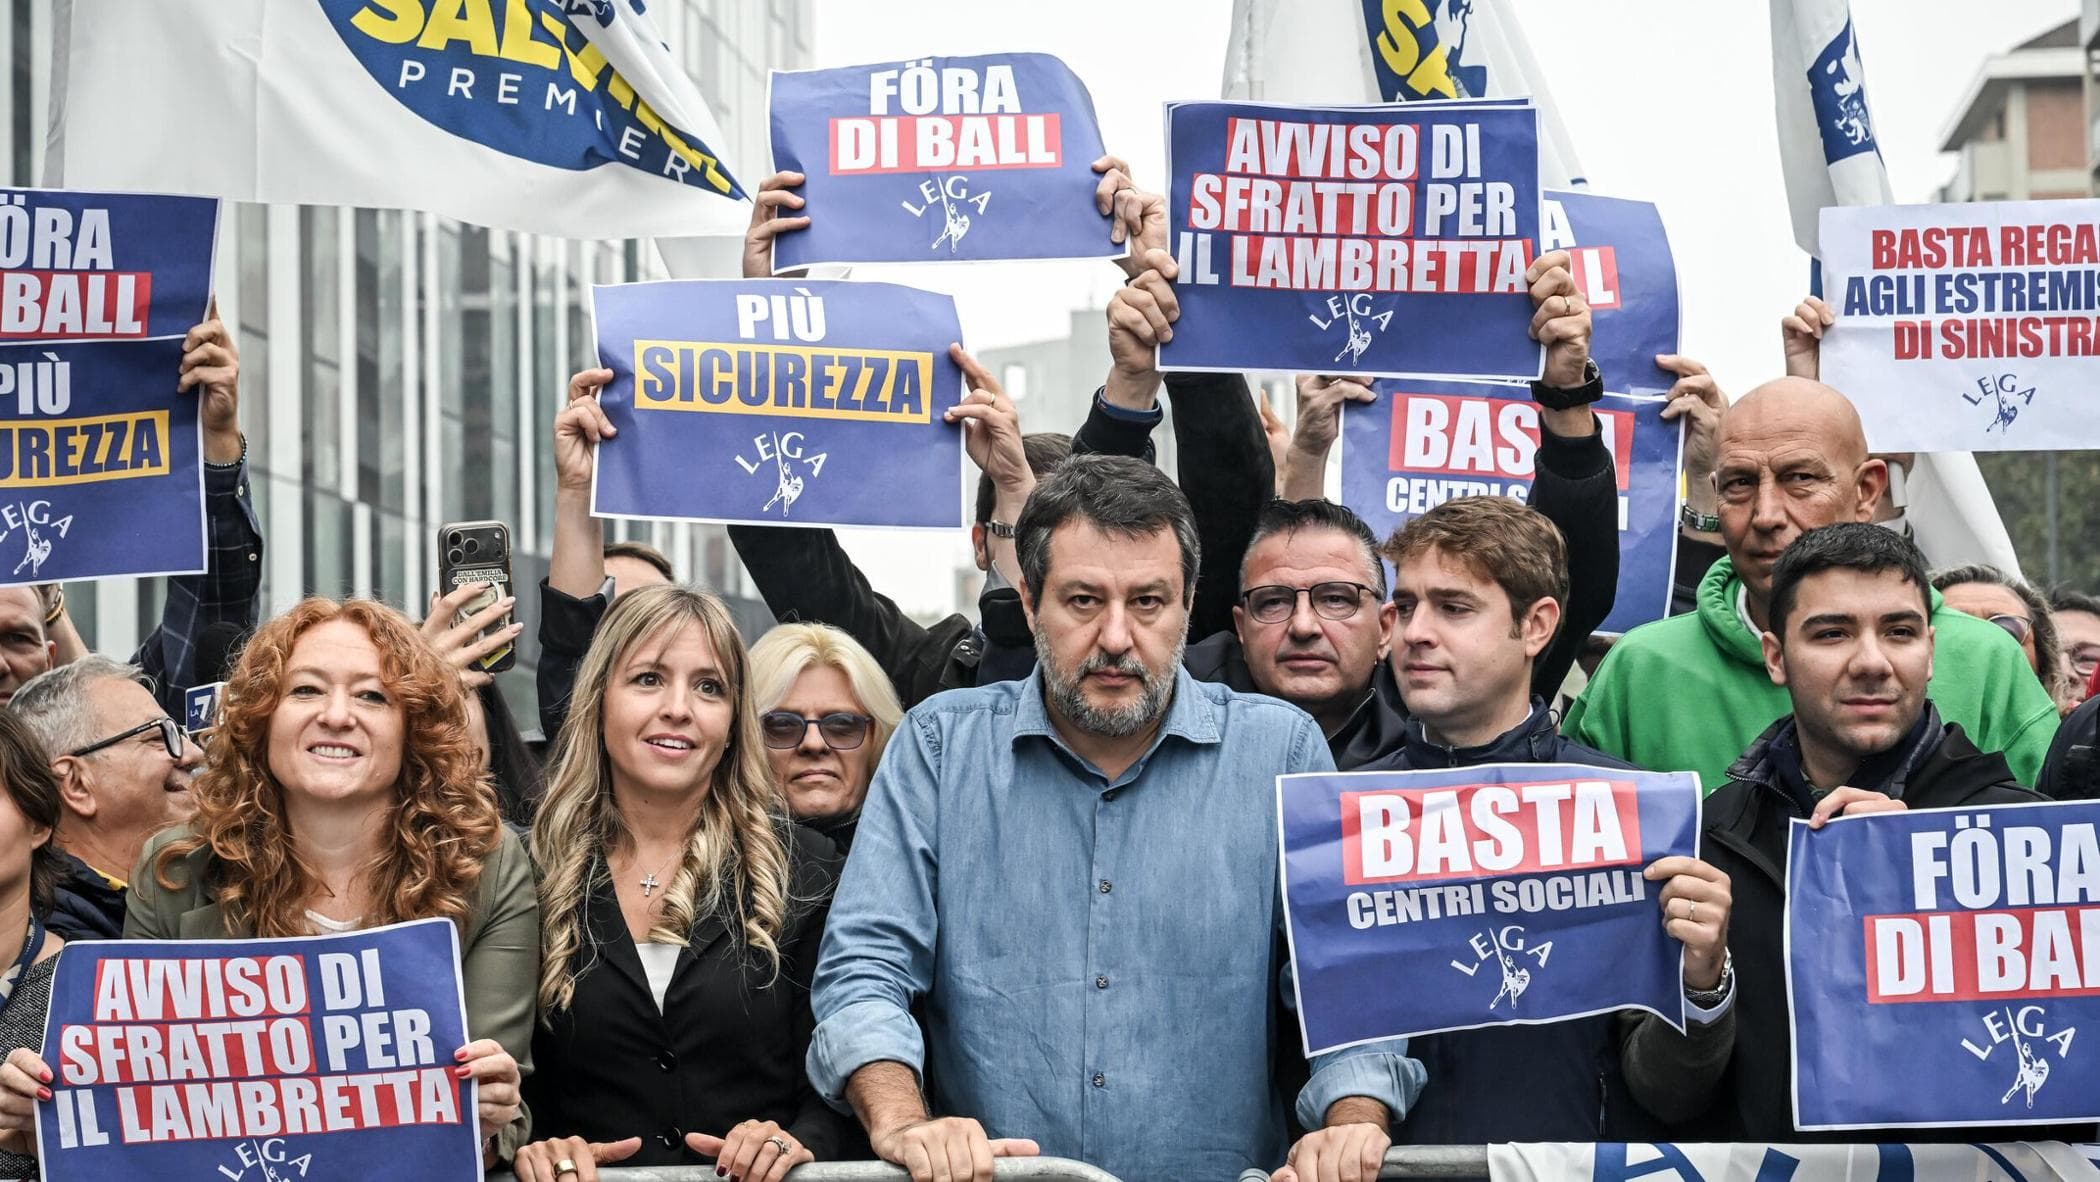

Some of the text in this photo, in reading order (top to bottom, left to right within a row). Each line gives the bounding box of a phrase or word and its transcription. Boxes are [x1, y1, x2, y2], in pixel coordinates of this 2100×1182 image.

[870, 59, 1021, 115] FÖRA
[837, 115, 1055, 170] DI BALL
[1227, 118, 1481, 179] AVVISO DI
[901, 176, 992, 217] LEGA
[1191, 174, 1410, 236] SFRATTO
[1425, 182, 1516, 236] PER
[1177, 232, 1219, 285] IL
[1232, 235, 1529, 293] LAMBRETTA
[1872, 224, 2100, 270] BASTA REGA
[1, 272, 142, 334] BALL
[736, 287, 826, 342] PIÙ
[1309, 293, 1395, 332] LEGA
[1843, 270, 2100, 316] AGLI ESTREMI
[1893, 316, 2100, 360] DI SINISTR
[642, 346, 923, 415] SICUREZZA
[1962, 373, 2037, 406] LEGA
[734, 431, 828, 477] LEGA
[1358, 781, 1629, 879] BASTA
[1911, 814, 2100, 910] FÖRA
[1346, 869, 1645, 930] CENTRI SOCIALI
[1450, 925, 1554, 977] LEGA
[1874, 914, 1955, 996] DI
[95, 948, 385, 1020] AVVISO DI
[61, 1008, 435, 1086] SFRATTO PER
[1960, 1005, 2077, 1061] LEGA
[54, 1068, 458, 1149] IL LAMBRETTA
[218, 1138, 313, 1182] LEGA
